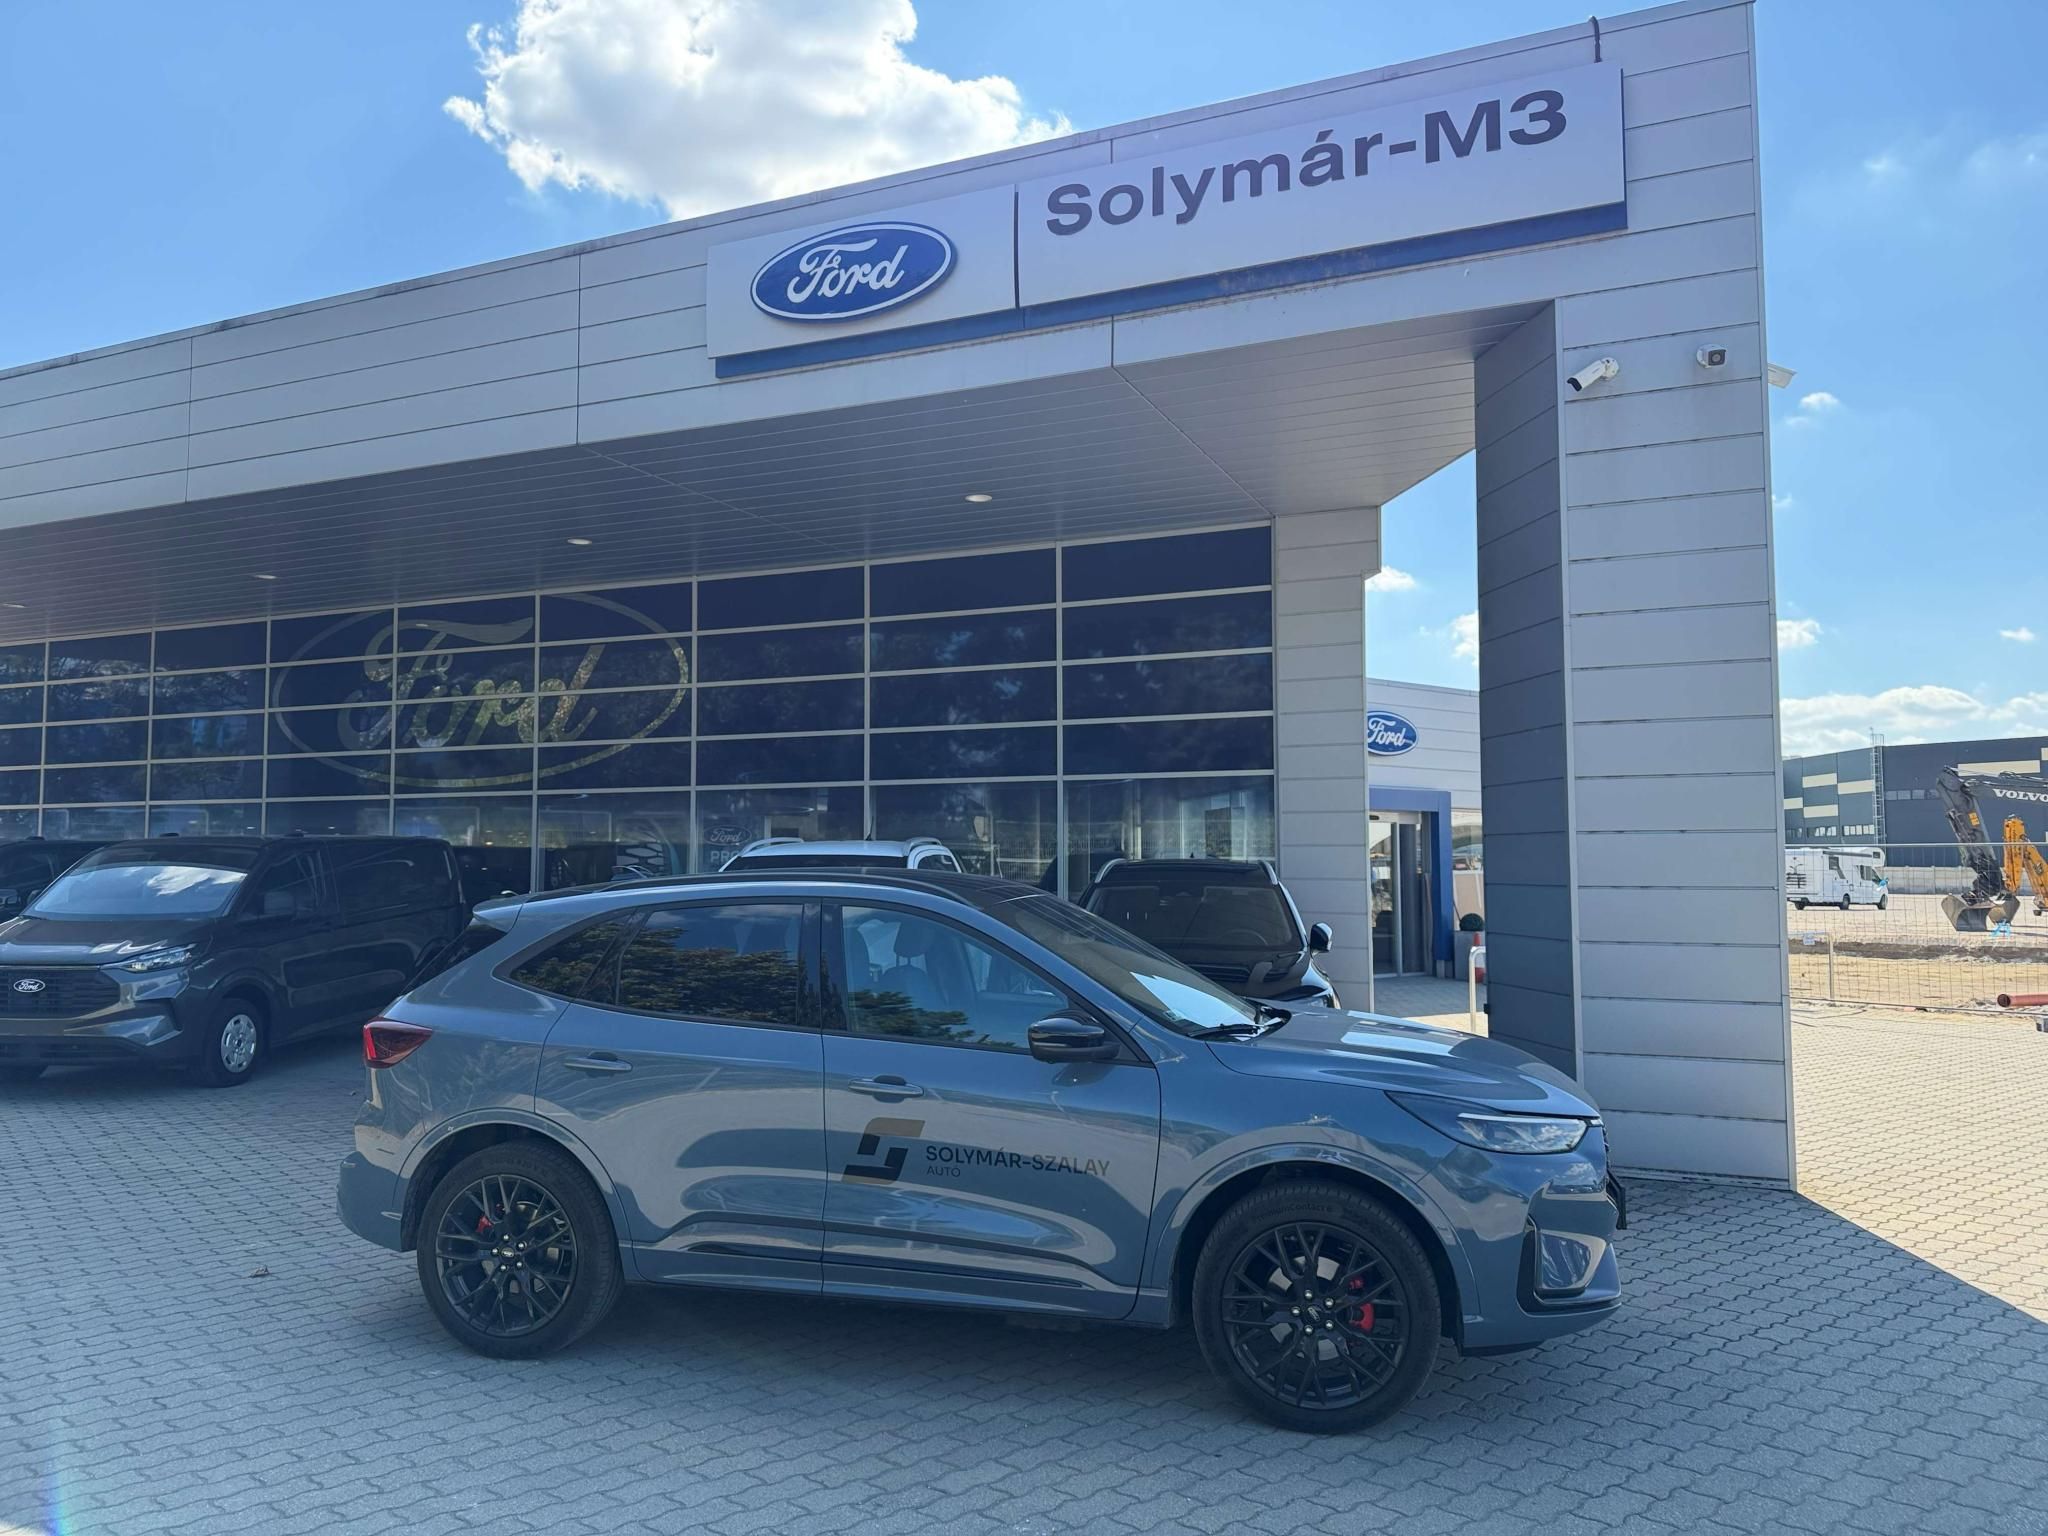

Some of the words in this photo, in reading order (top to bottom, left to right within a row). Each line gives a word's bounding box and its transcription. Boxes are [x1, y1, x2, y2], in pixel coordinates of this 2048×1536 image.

[1046, 89, 1567, 236] Solymár-M3
[787, 238, 908, 303] Ford
[337, 616, 606, 749] Ford
[1368, 717, 1406, 747] Ford
[1992, 788, 2048, 803] VOLVO
[710, 827, 742, 843] Ford
[926, 1146, 1110, 1176] SOLYMÁR-SZALAY
